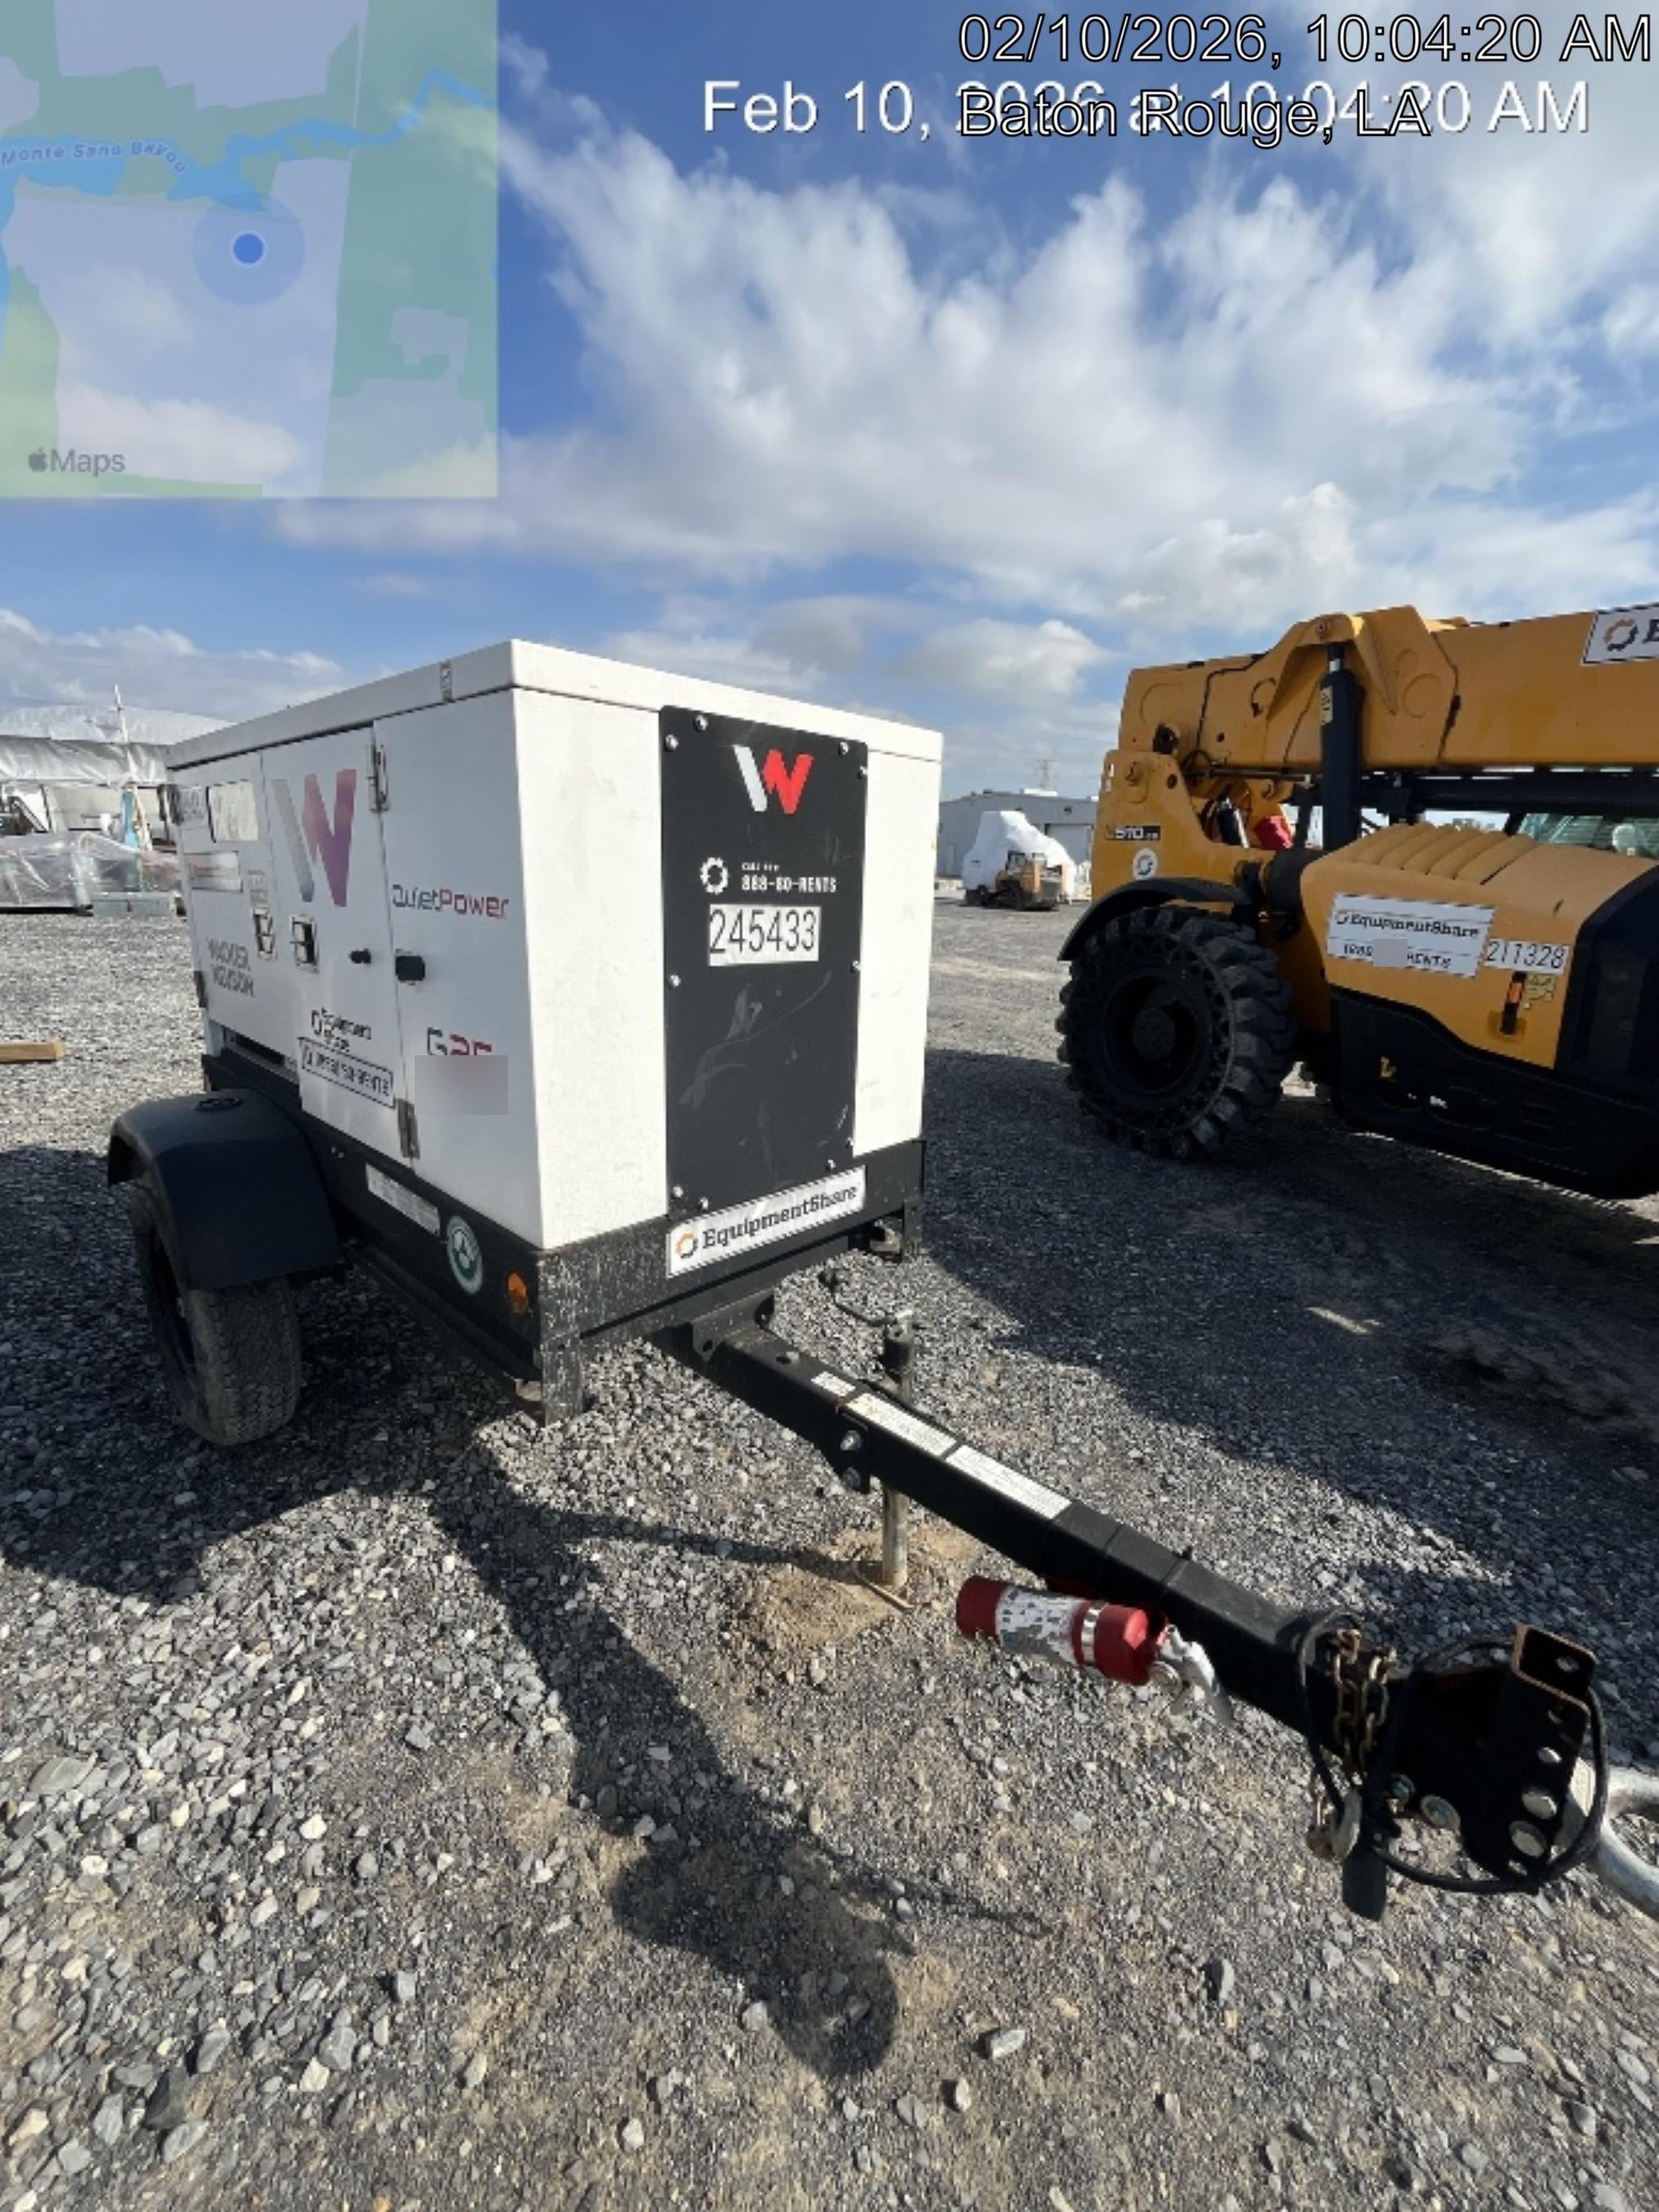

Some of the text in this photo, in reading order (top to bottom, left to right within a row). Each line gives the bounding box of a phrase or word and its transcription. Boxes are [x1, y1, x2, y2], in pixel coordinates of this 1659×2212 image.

[392, 883, 510, 919] QuietPower
[709, 908, 817, 954] 245433
[1351, 913, 1479, 939] EquipmentShare
[702, 1185, 858, 1250] EquipmentShare
